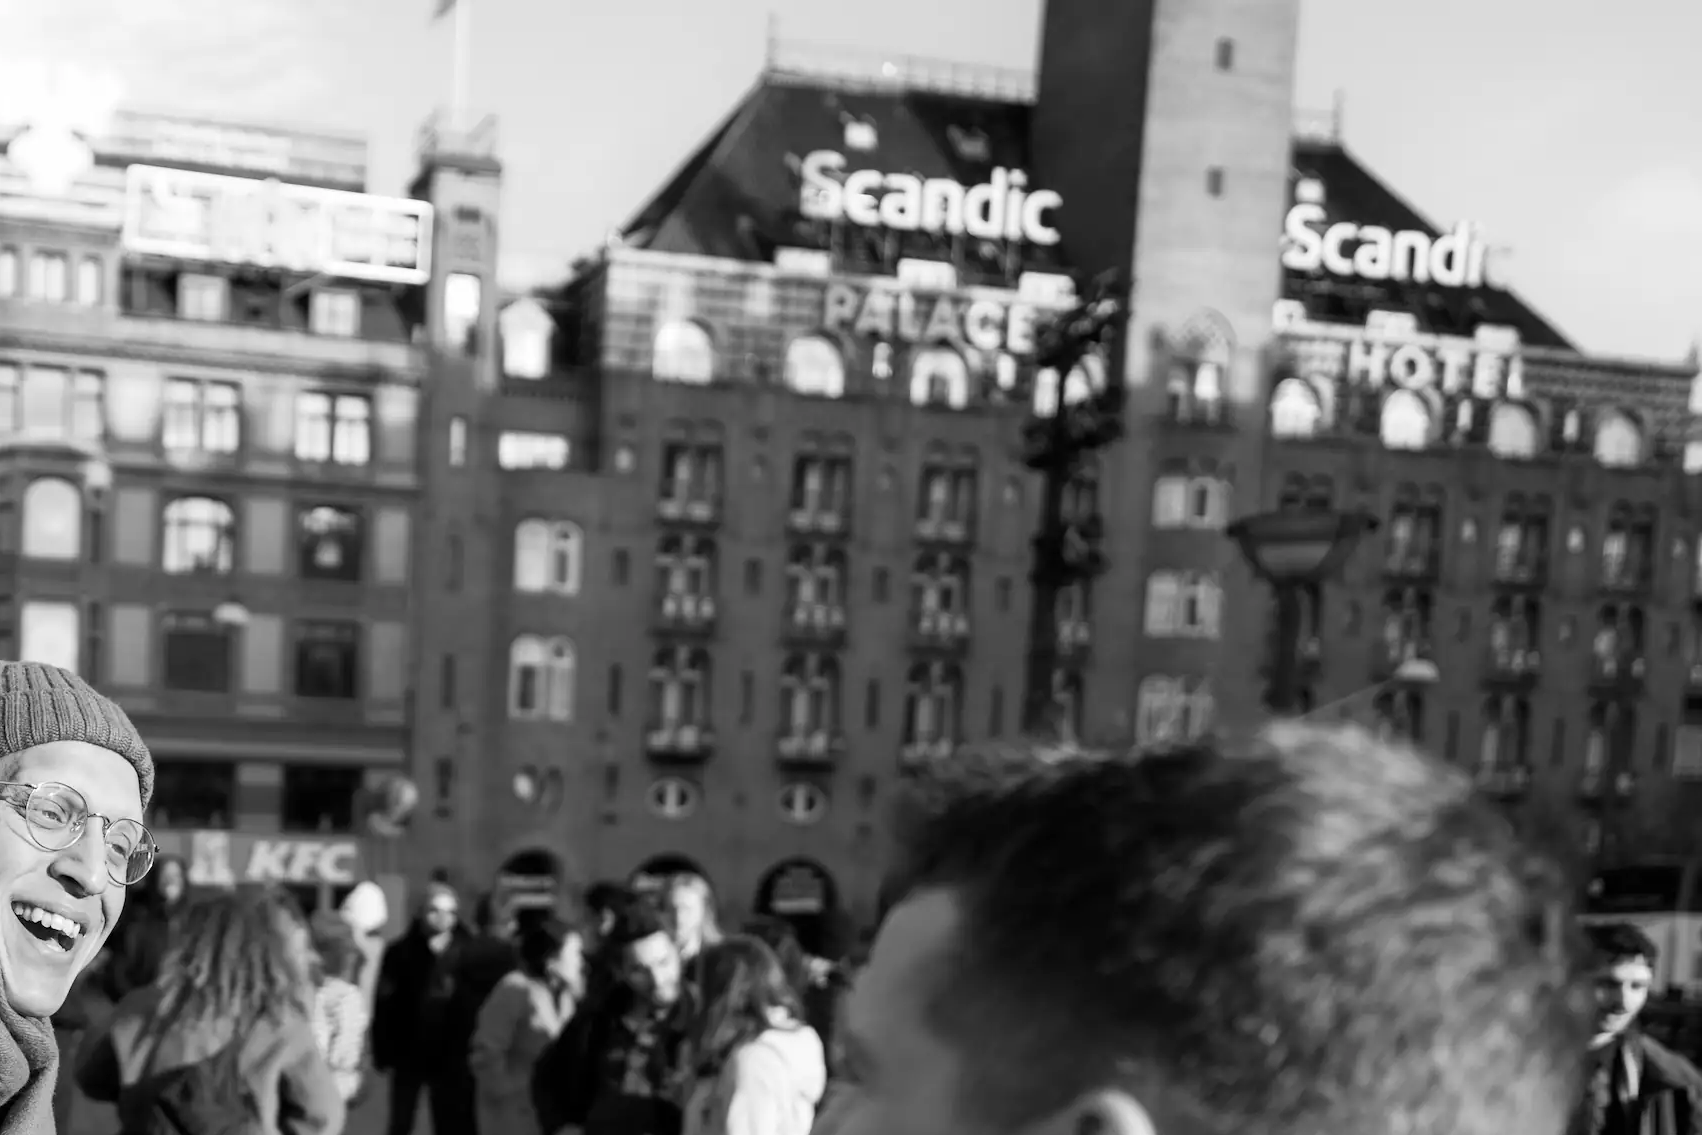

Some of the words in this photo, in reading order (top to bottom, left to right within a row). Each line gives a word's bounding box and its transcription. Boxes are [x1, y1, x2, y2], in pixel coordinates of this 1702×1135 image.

[799, 149, 1064, 246] Scandic
[824, 284, 1036, 353] PALACE
[244, 840, 358, 884] KFC
